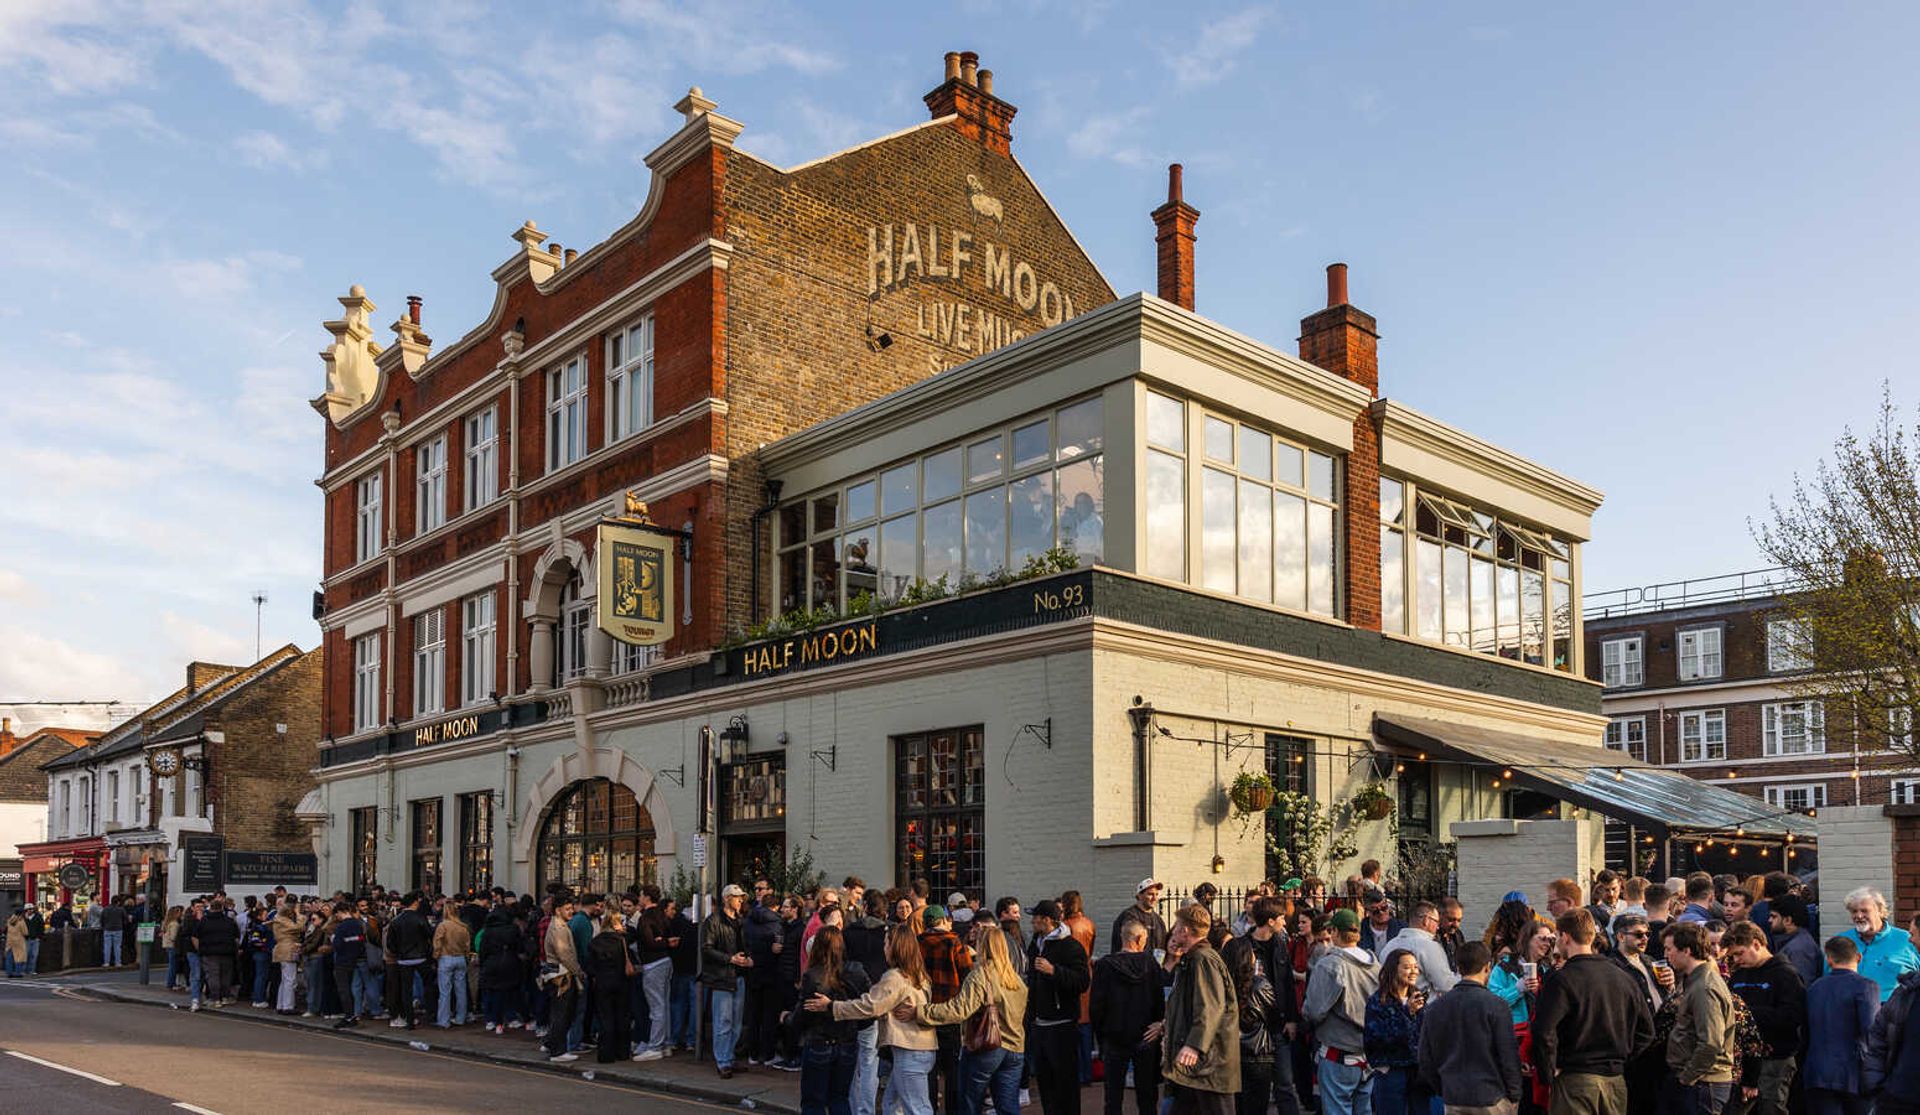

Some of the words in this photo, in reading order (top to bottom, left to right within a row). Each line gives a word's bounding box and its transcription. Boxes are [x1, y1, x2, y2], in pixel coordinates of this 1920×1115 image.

[868, 222, 972, 296] HALF
[917, 303, 971, 350] LIVE
[616, 545, 634, 555] HALF
[636, 548, 657, 558] MOON
[744, 642, 794, 675] HALF
[801, 624, 876, 663] MOON
[416, 725, 440, 747] HALF
[443, 716, 478, 741] MOON
